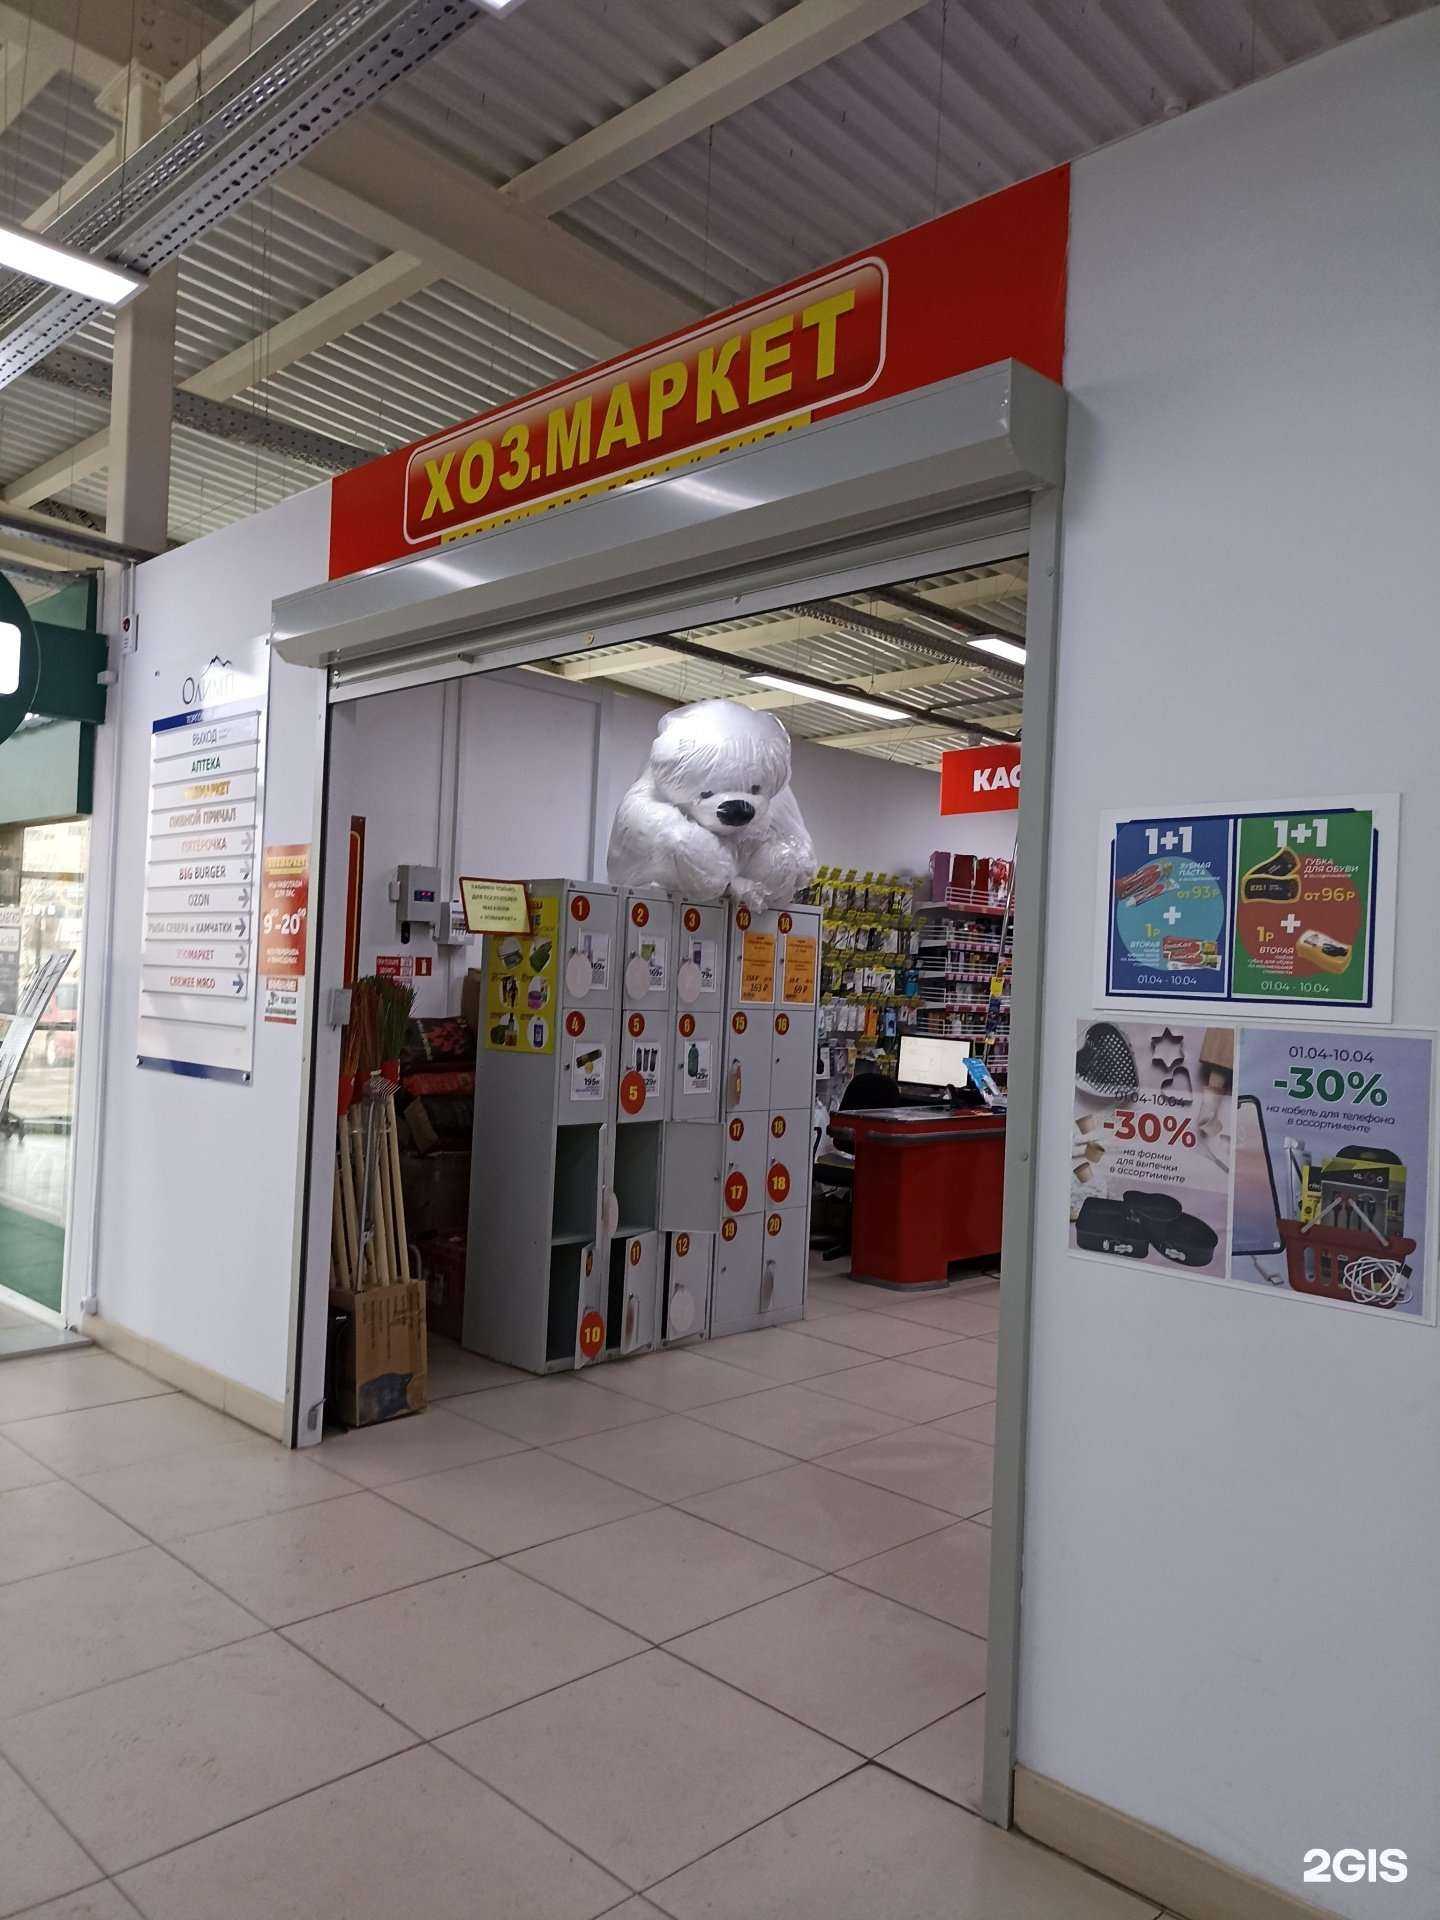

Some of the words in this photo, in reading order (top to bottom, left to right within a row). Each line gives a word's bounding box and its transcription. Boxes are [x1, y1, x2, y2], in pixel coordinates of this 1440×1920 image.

[420, 288, 856, 522] ХОЗ.МАРКЕТ
[192, 728, 217, 746] ВЫХОД
[191, 757, 221, 773] АПТЕКА
[203, 806, 237, 825] ПРИЧАЛ
[1145, 826, 1193, 854] 1+1
[1273, 818, 1329, 848] 1+1
[1303, 865, 1325, 874] ДЛЯ
[1325, 865, 1361, 873] ОБУВИ
[1304, 858, 1334, 866] ГУБКА
[179, 867, 193, 880] BIG
[194, 864, 226, 879] BURGER
[187, 893, 210, 908] OZON
[637, 907, 644, 923] 2
[689, 912, 696, 928] 3
[782, 916, 790, 928] 14
[195, 921, 233, 935] КАМЧАТКИ
[1259, 946, 1294, 954] ВТОРАЯ
[1261, 981, 1290, 991] 01.04
[1299, 982, 1330, 993] 10.04
[571, 1016, 579, 1032] 4
[633, 1017, 640, 1032] 5
[684, 1018, 690, 1033] 6
[735, 1017, 745, 1031] 15
[778, 1018, 787, 1031] 16
[1289, 1046, 1375, 1063] 01.04-10.04
[628, 1085, 638, 1101] 5
[1273, 1066, 1388, 1107] -30%
[1266, 1105, 1280, 1113] на
[1281, 1106, 1318, 1117] кабель
[1319, 1110, 1340, 1118] для
[1343, 1112, 1396, 1125] телефона
[732, 1122, 741, 1134] 17
[774, 1120, 784, 1134] 18
[1103, 1110, 1197, 1148] -30%
[1287, 1118, 1295, 1126] в
[1296, 1119, 1371, 1133] ассортименте
[1123, 1149, 1136, 1157] на
[1137, 1149, 1172, 1161] формы
[1116, 1157, 1134, 1166] для
[1136, 1161, 1178, 1172] выпечки
[1109, 1165, 1115, 1173] в
[1117, 1166, 1186, 1183] ассортименте
[771, 1176, 786, 1190] 18
[730, 1185, 743, 1200] 17
[724, 1224, 735, 1238] 19
[769, 1218, 780, 1232] 20
[631, 1245, 640, 1258] 11
[678, 1238, 688, 1254] 12
[584, 1326, 601, 1344] 10
